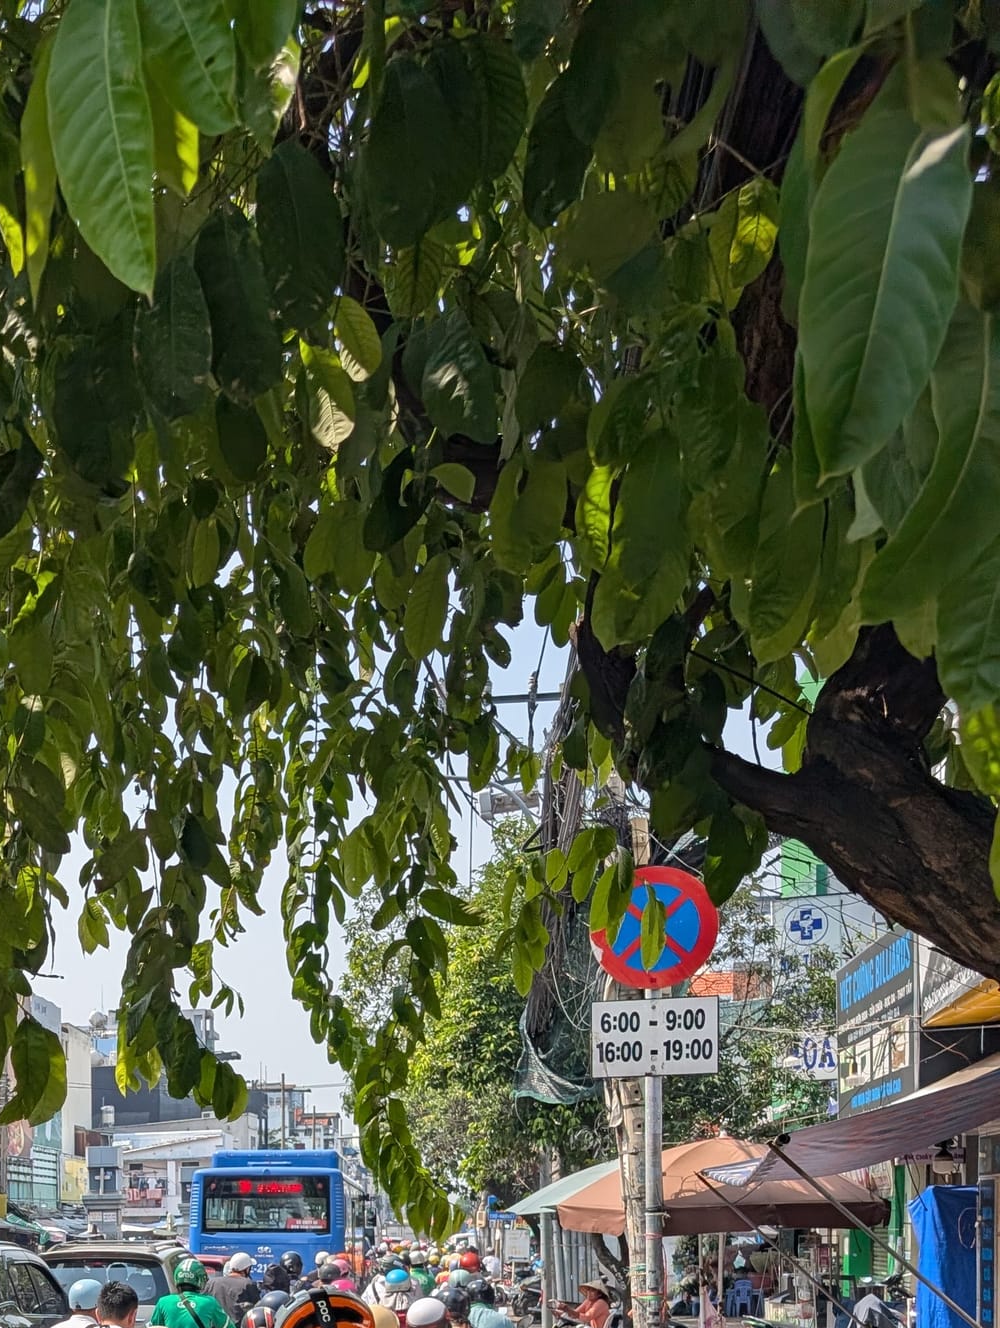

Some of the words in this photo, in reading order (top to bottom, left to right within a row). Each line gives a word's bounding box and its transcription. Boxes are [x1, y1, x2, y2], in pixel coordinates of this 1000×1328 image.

[600, 1011, 640, 1033] 6:00
[665, 1008, 706, 1031] 9:00
[596, 1040, 643, 1063] 16:00
[663, 1038, 713, 1061] 19:00
